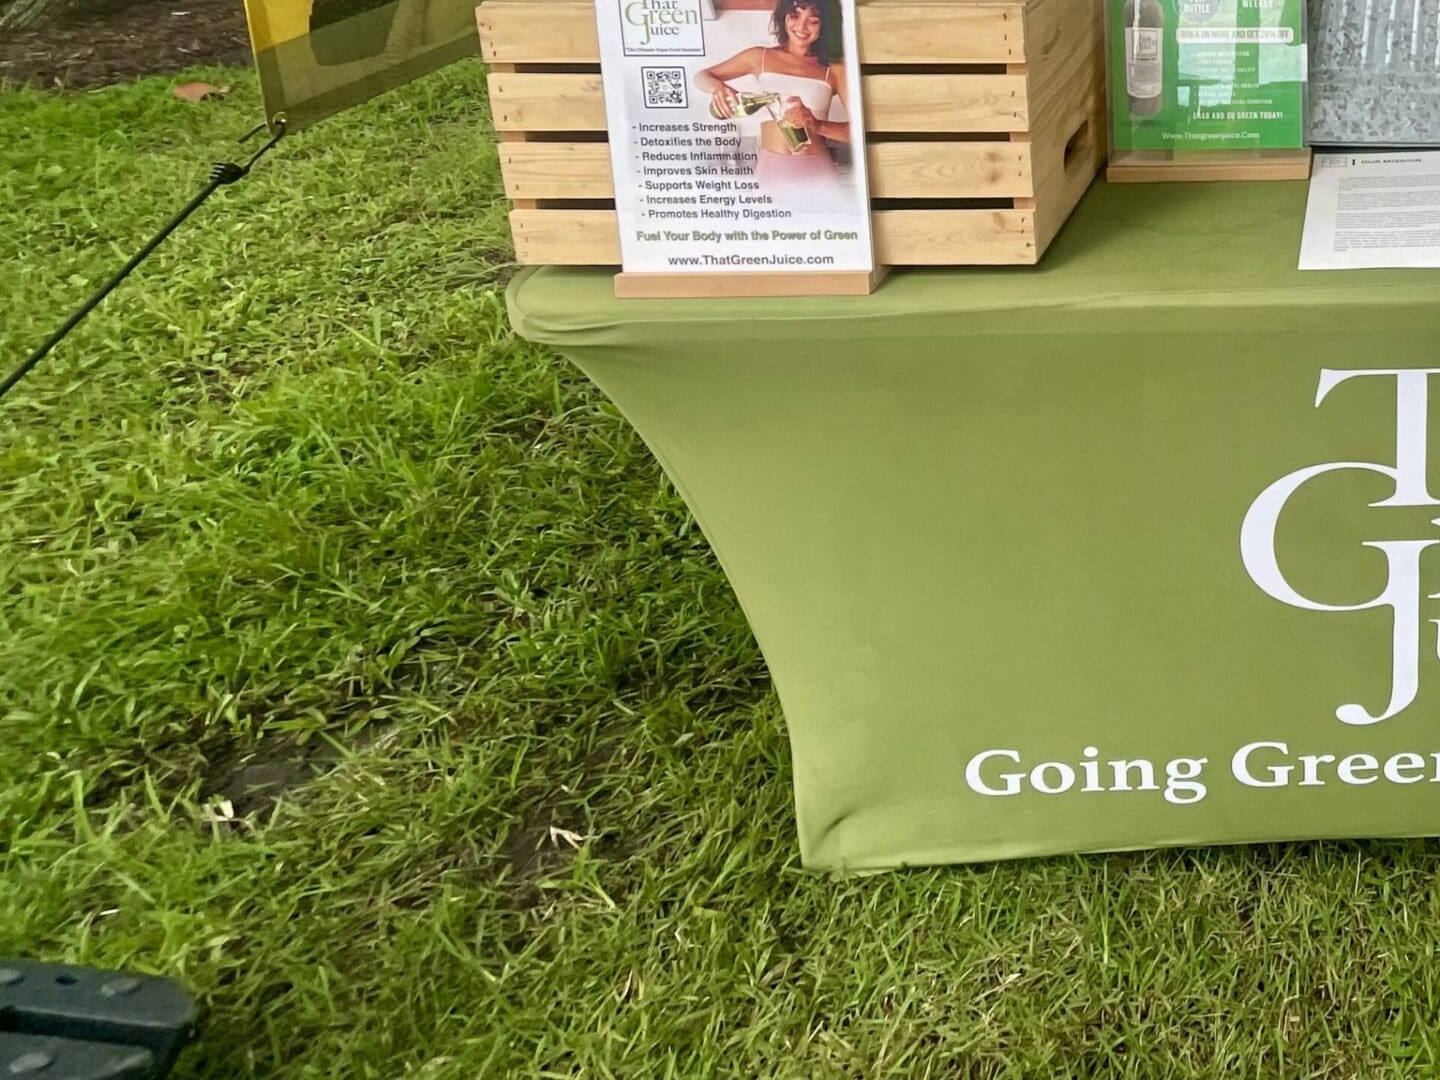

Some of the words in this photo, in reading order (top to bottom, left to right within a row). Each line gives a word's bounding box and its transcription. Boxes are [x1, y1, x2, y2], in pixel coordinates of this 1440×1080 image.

[639, 122, 689, 132] Increases
[692, 122, 737, 135] Strength
[640, 136, 695, 147] Detoxifies
[698, 136, 712, 147] the
[715, 137, 741, 149] Body
[668, 254, 834, 266] www.ThatGreenJuice.com
[964, 746, 1209, 804] Going
